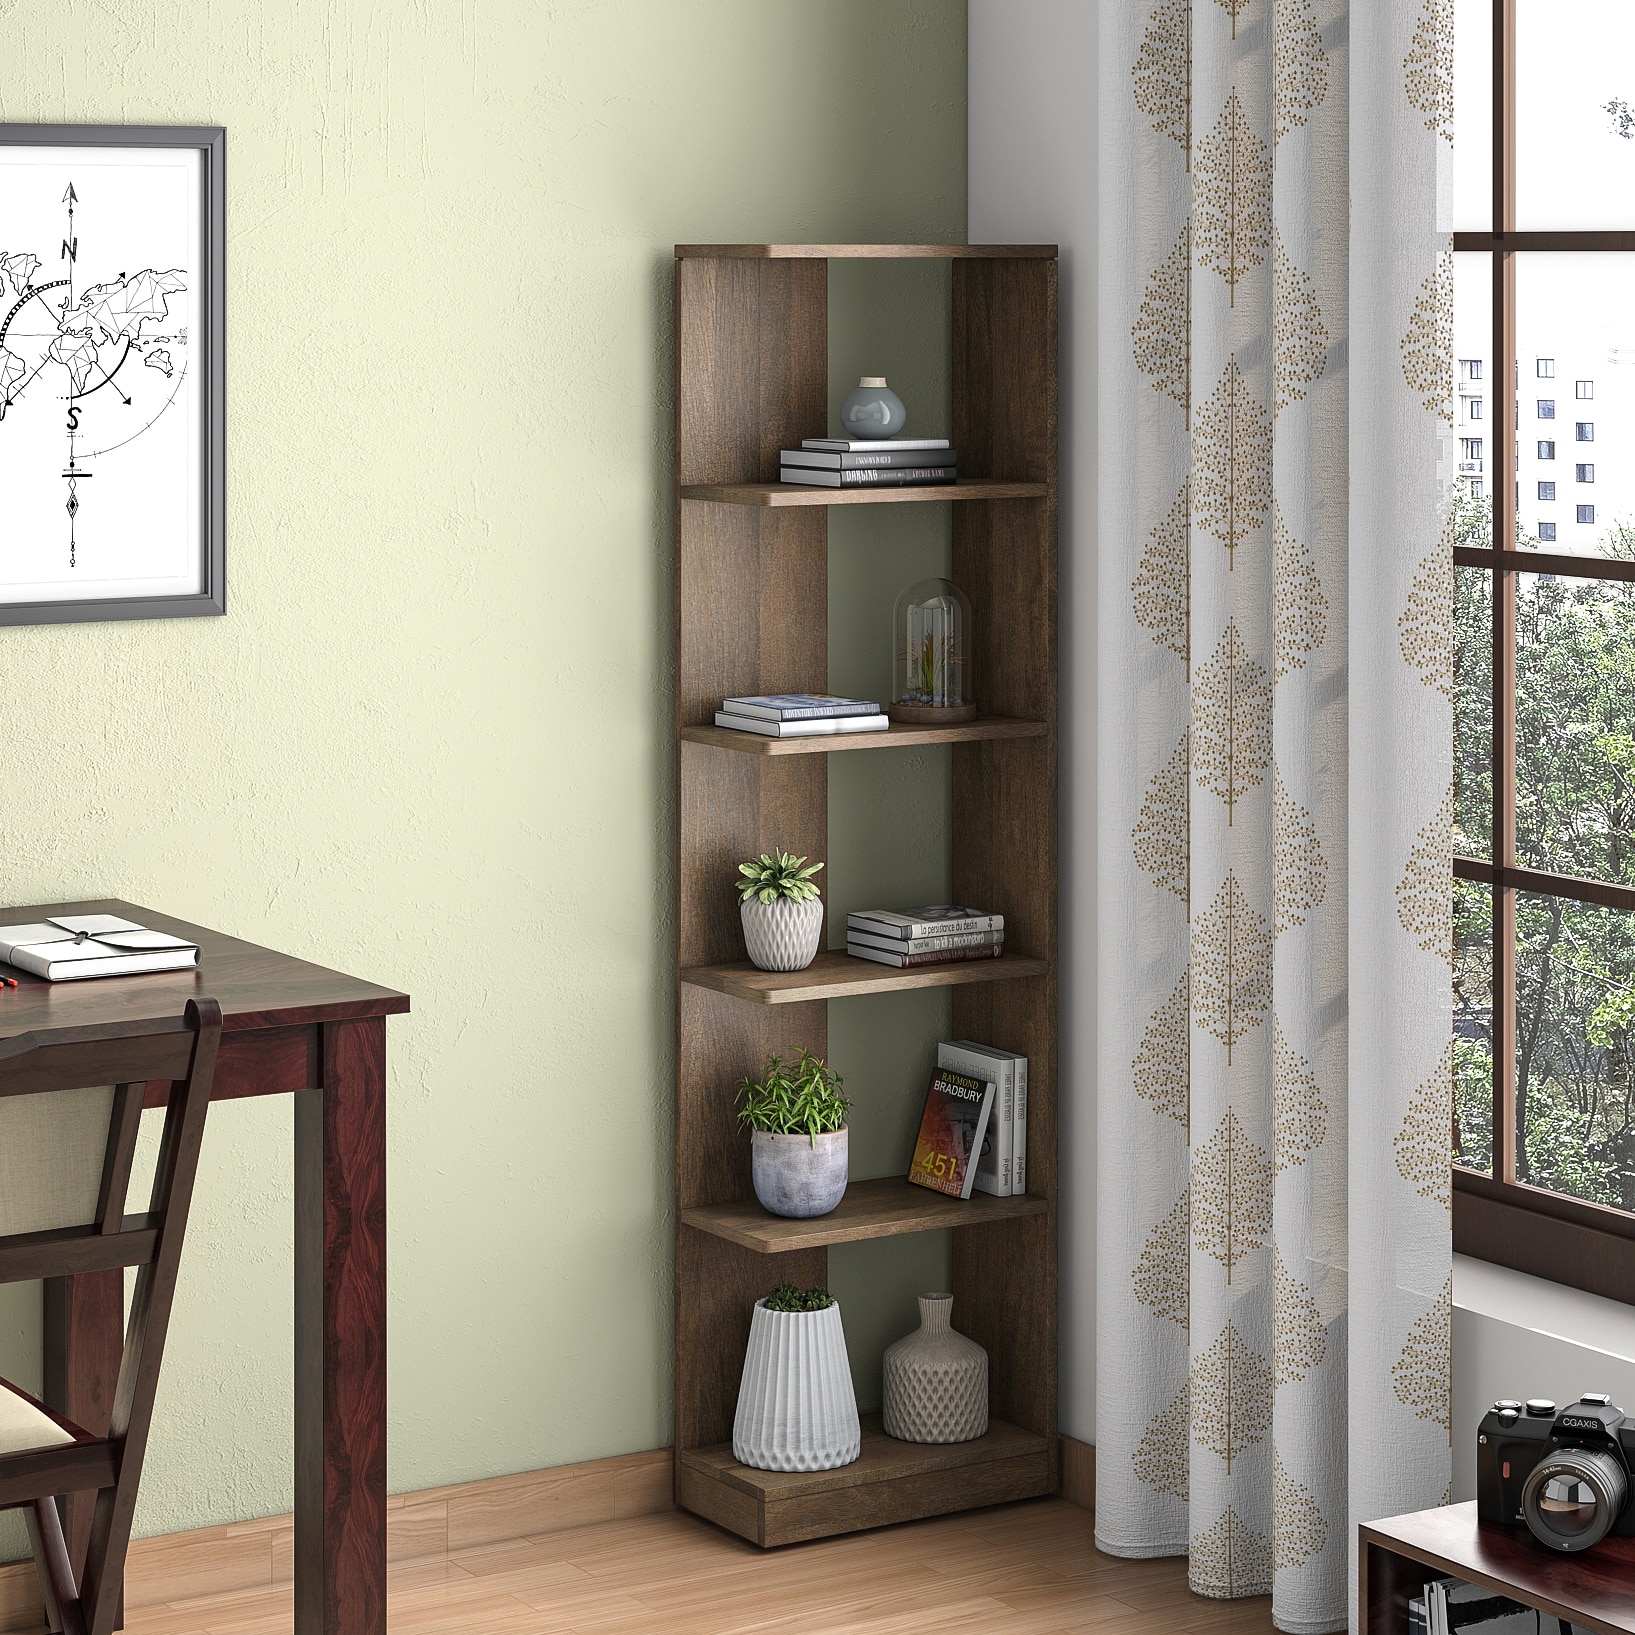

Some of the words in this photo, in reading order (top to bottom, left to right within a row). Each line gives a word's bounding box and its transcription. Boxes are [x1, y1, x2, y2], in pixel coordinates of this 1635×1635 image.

[61, 237, 78, 262] N
[66, 407, 82, 430] S
[920, 925, 927, 935] La
[927, 922, 955, 937] persistance
[956, 920, 962, 932] du
[963, 919, 978, 931] destin
[953, 931, 985, 947] mockingbird
[941, 1072, 979, 1090] RAYMOND
[933, 1080, 982, 1103] BRADBURY
[922, 1151, 957, 1180] 451
[1562, 1417, 1598, 1429] CGAXIS
